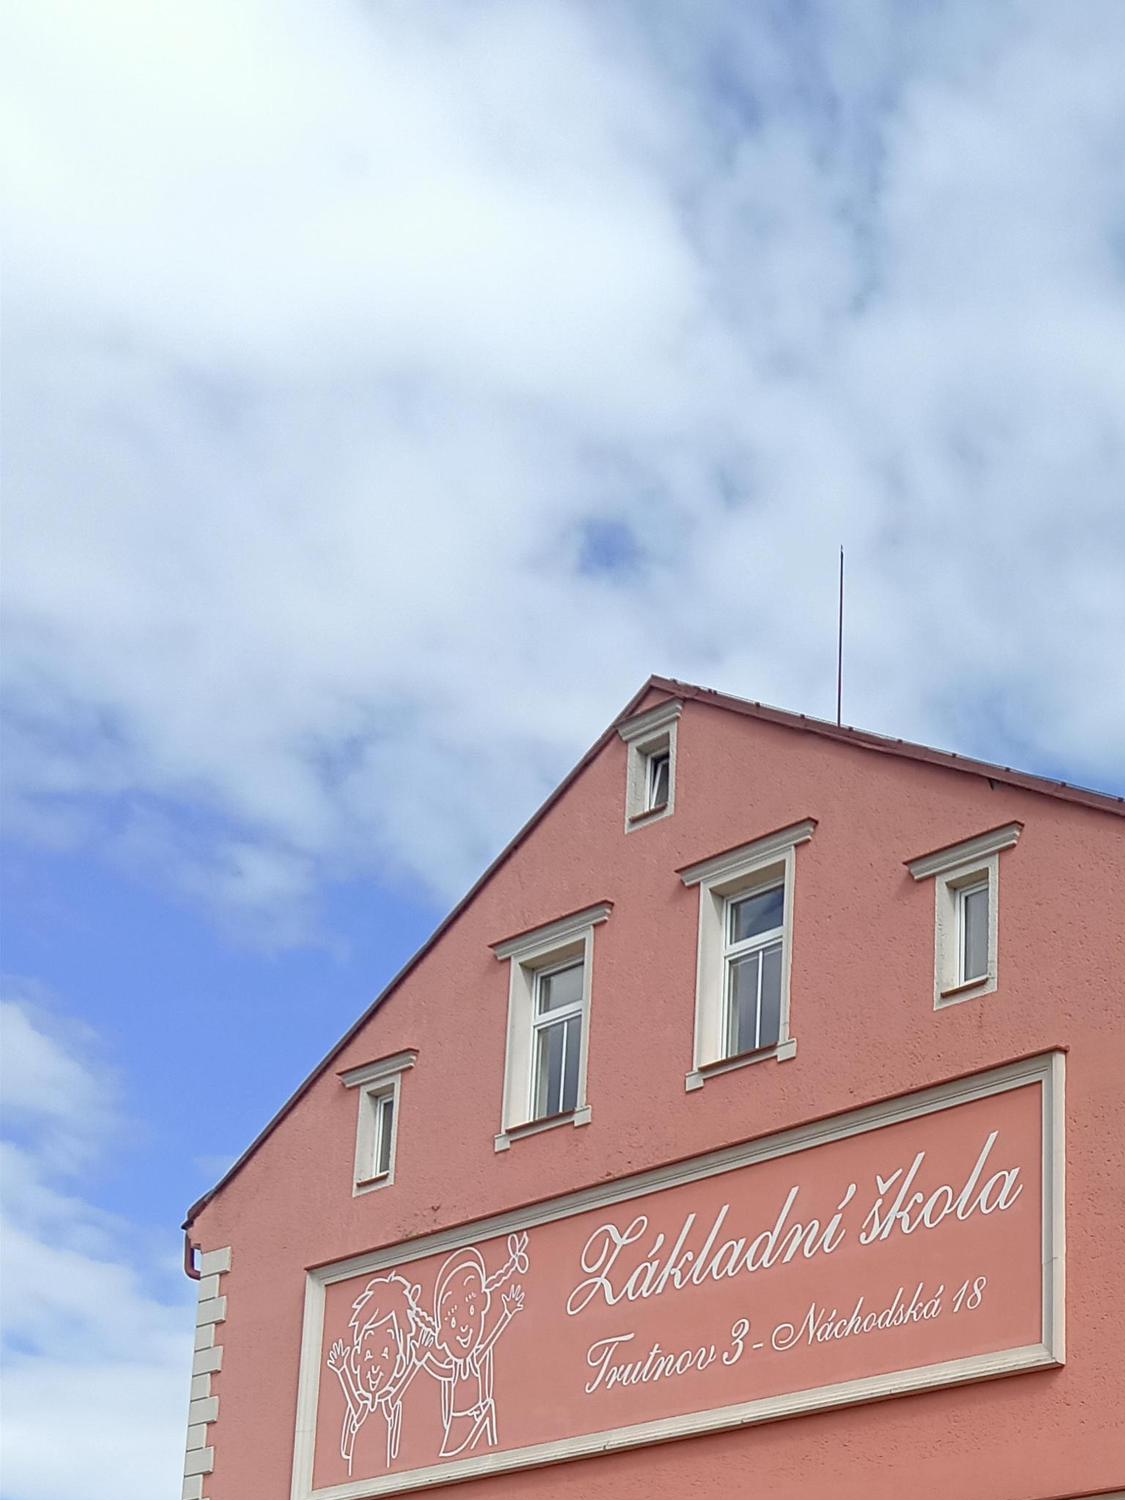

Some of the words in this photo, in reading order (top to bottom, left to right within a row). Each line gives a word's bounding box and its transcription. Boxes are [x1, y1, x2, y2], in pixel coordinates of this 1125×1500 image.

[566, 1183, 858, 1316] Základní
[860, 1129, 1024, 1246] škola
[584, 1332, 717, 1394] Trutnov
[722, 1317, 750, 1366] 3
[771, 1281, 945, 1352] Náchodská
[952, 1275, 988, 1313] 18
